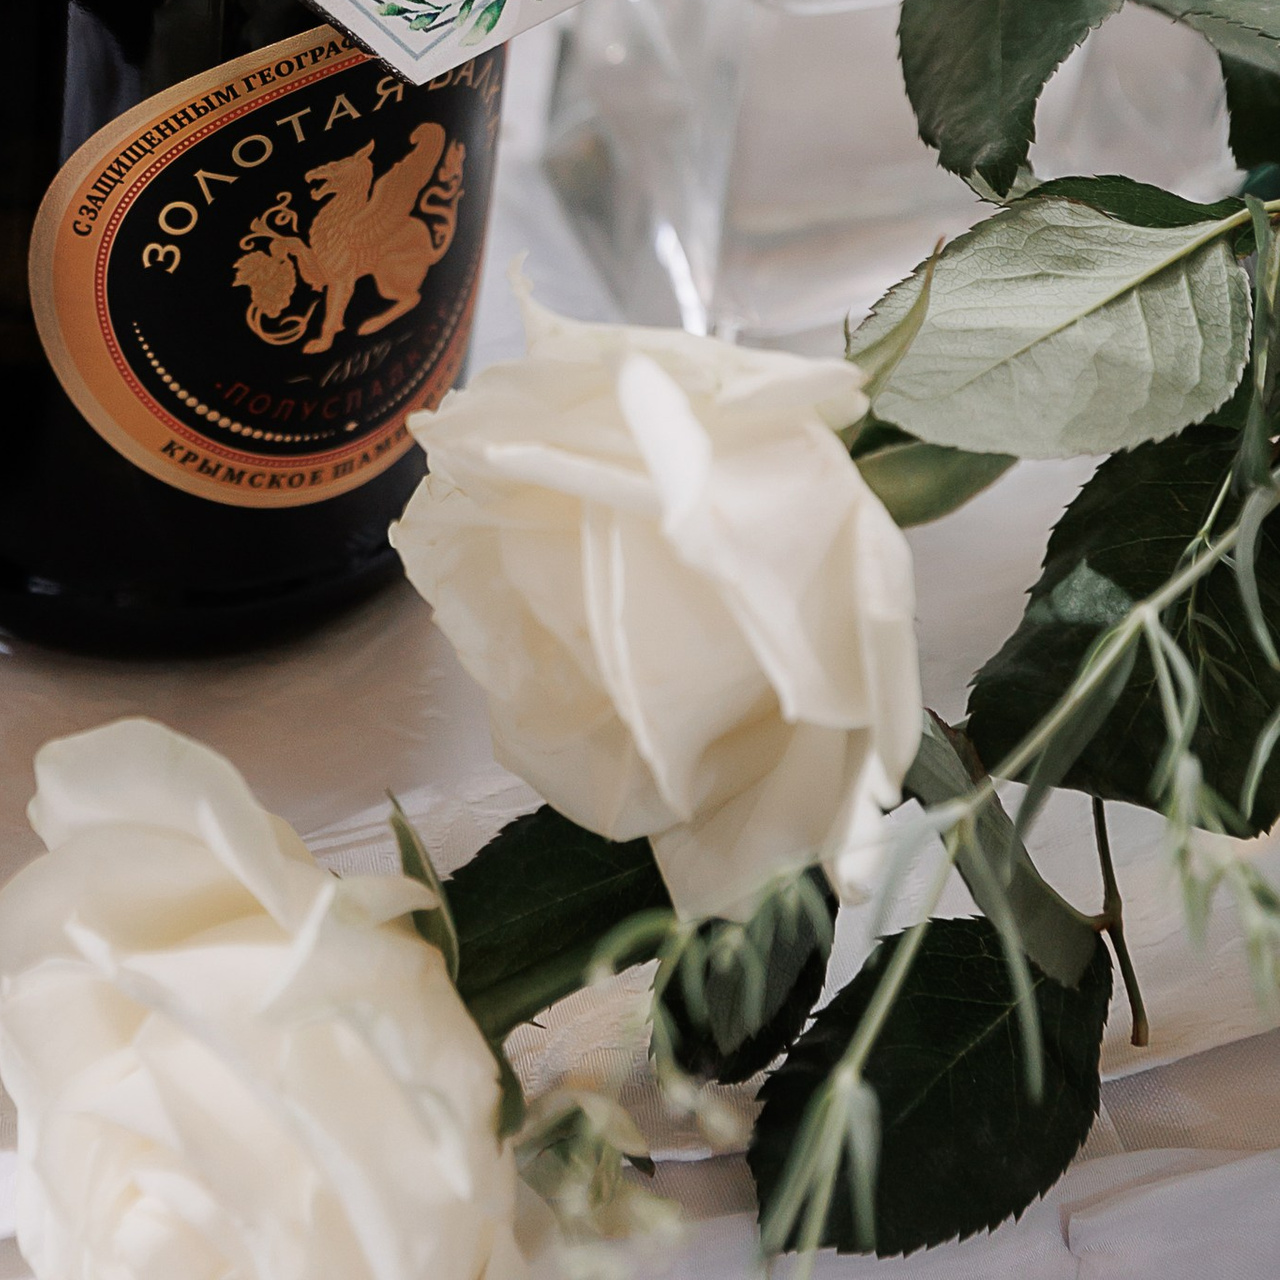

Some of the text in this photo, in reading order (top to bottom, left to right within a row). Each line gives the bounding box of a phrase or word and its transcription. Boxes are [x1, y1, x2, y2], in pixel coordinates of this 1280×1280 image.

[79, 85, 241, 221] ЗАЩИЩЕННЫМ
[142, 75, 404, 274] ЗОЛОТАЯ
[160, 438, 324, 491] КРЫМСКОЕ
